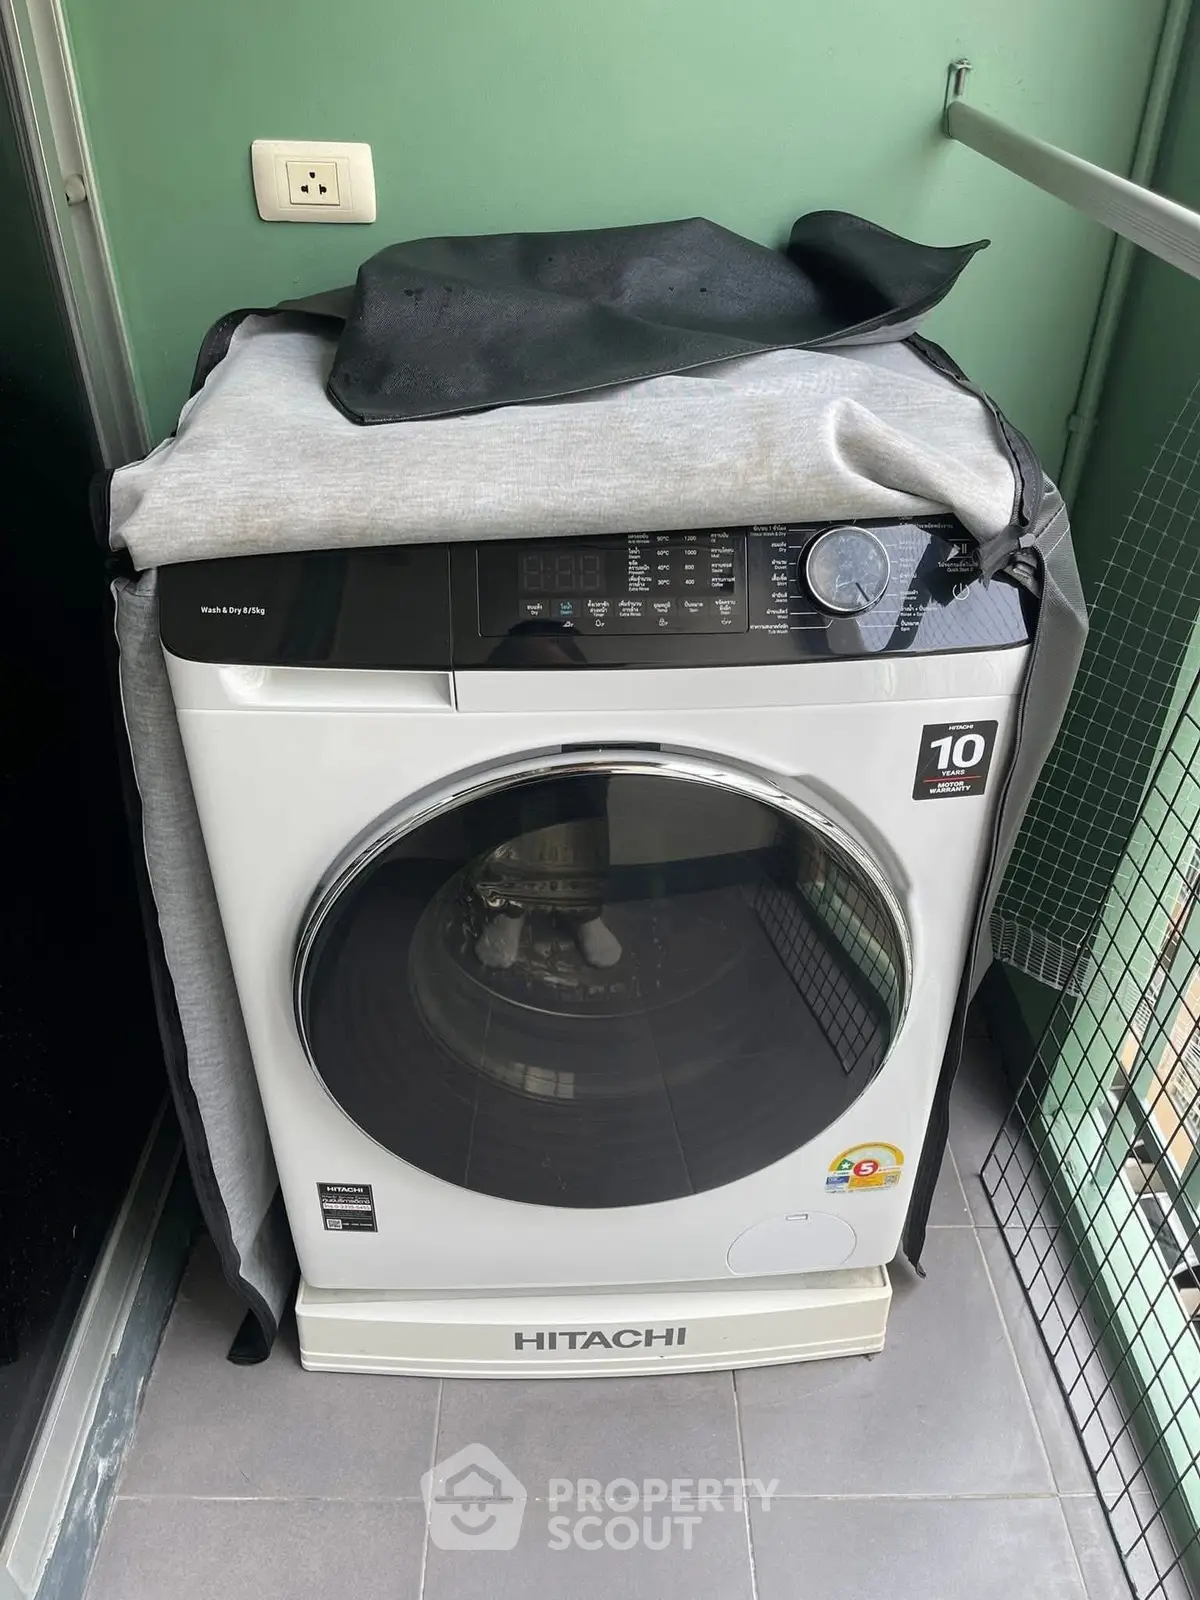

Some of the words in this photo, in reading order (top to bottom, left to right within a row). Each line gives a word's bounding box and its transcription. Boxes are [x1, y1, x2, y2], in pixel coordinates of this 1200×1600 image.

[229, 606, 242, 615] Dry
[242, 606, 265, 615] 8/5kg
[930, 733, 985, 769] 10
[929, 785, 971, 794] WARRANTY
[859, 1162, 875, 1175] 5
[514, 1327, 687, 1350] HITACHI
